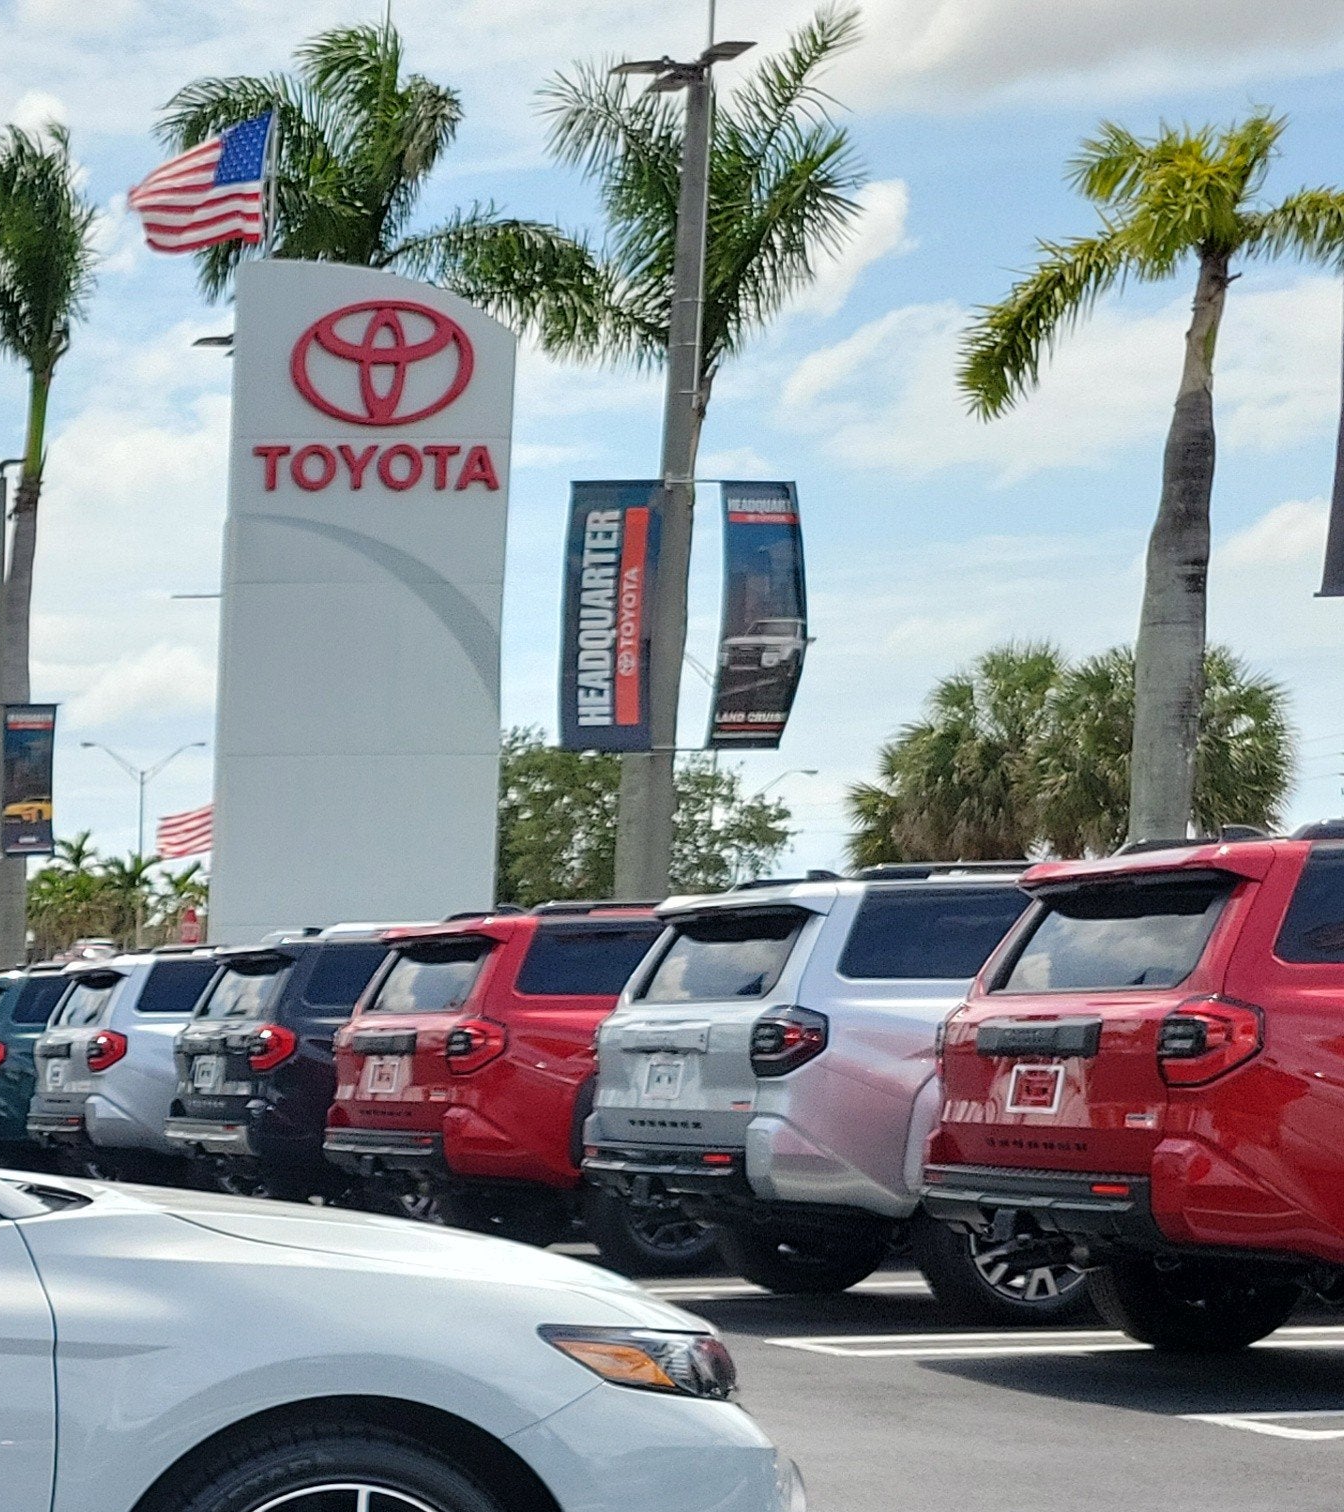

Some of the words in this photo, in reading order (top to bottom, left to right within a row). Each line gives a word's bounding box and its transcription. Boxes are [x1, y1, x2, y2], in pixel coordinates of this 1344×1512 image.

[252, 443, 500, 492] TOYOTA
[577, 509, 622, 727] HEADQUARTER
[620, 567, 639, 648] TOYOTA
[714, 711, 746, 723] LAND
